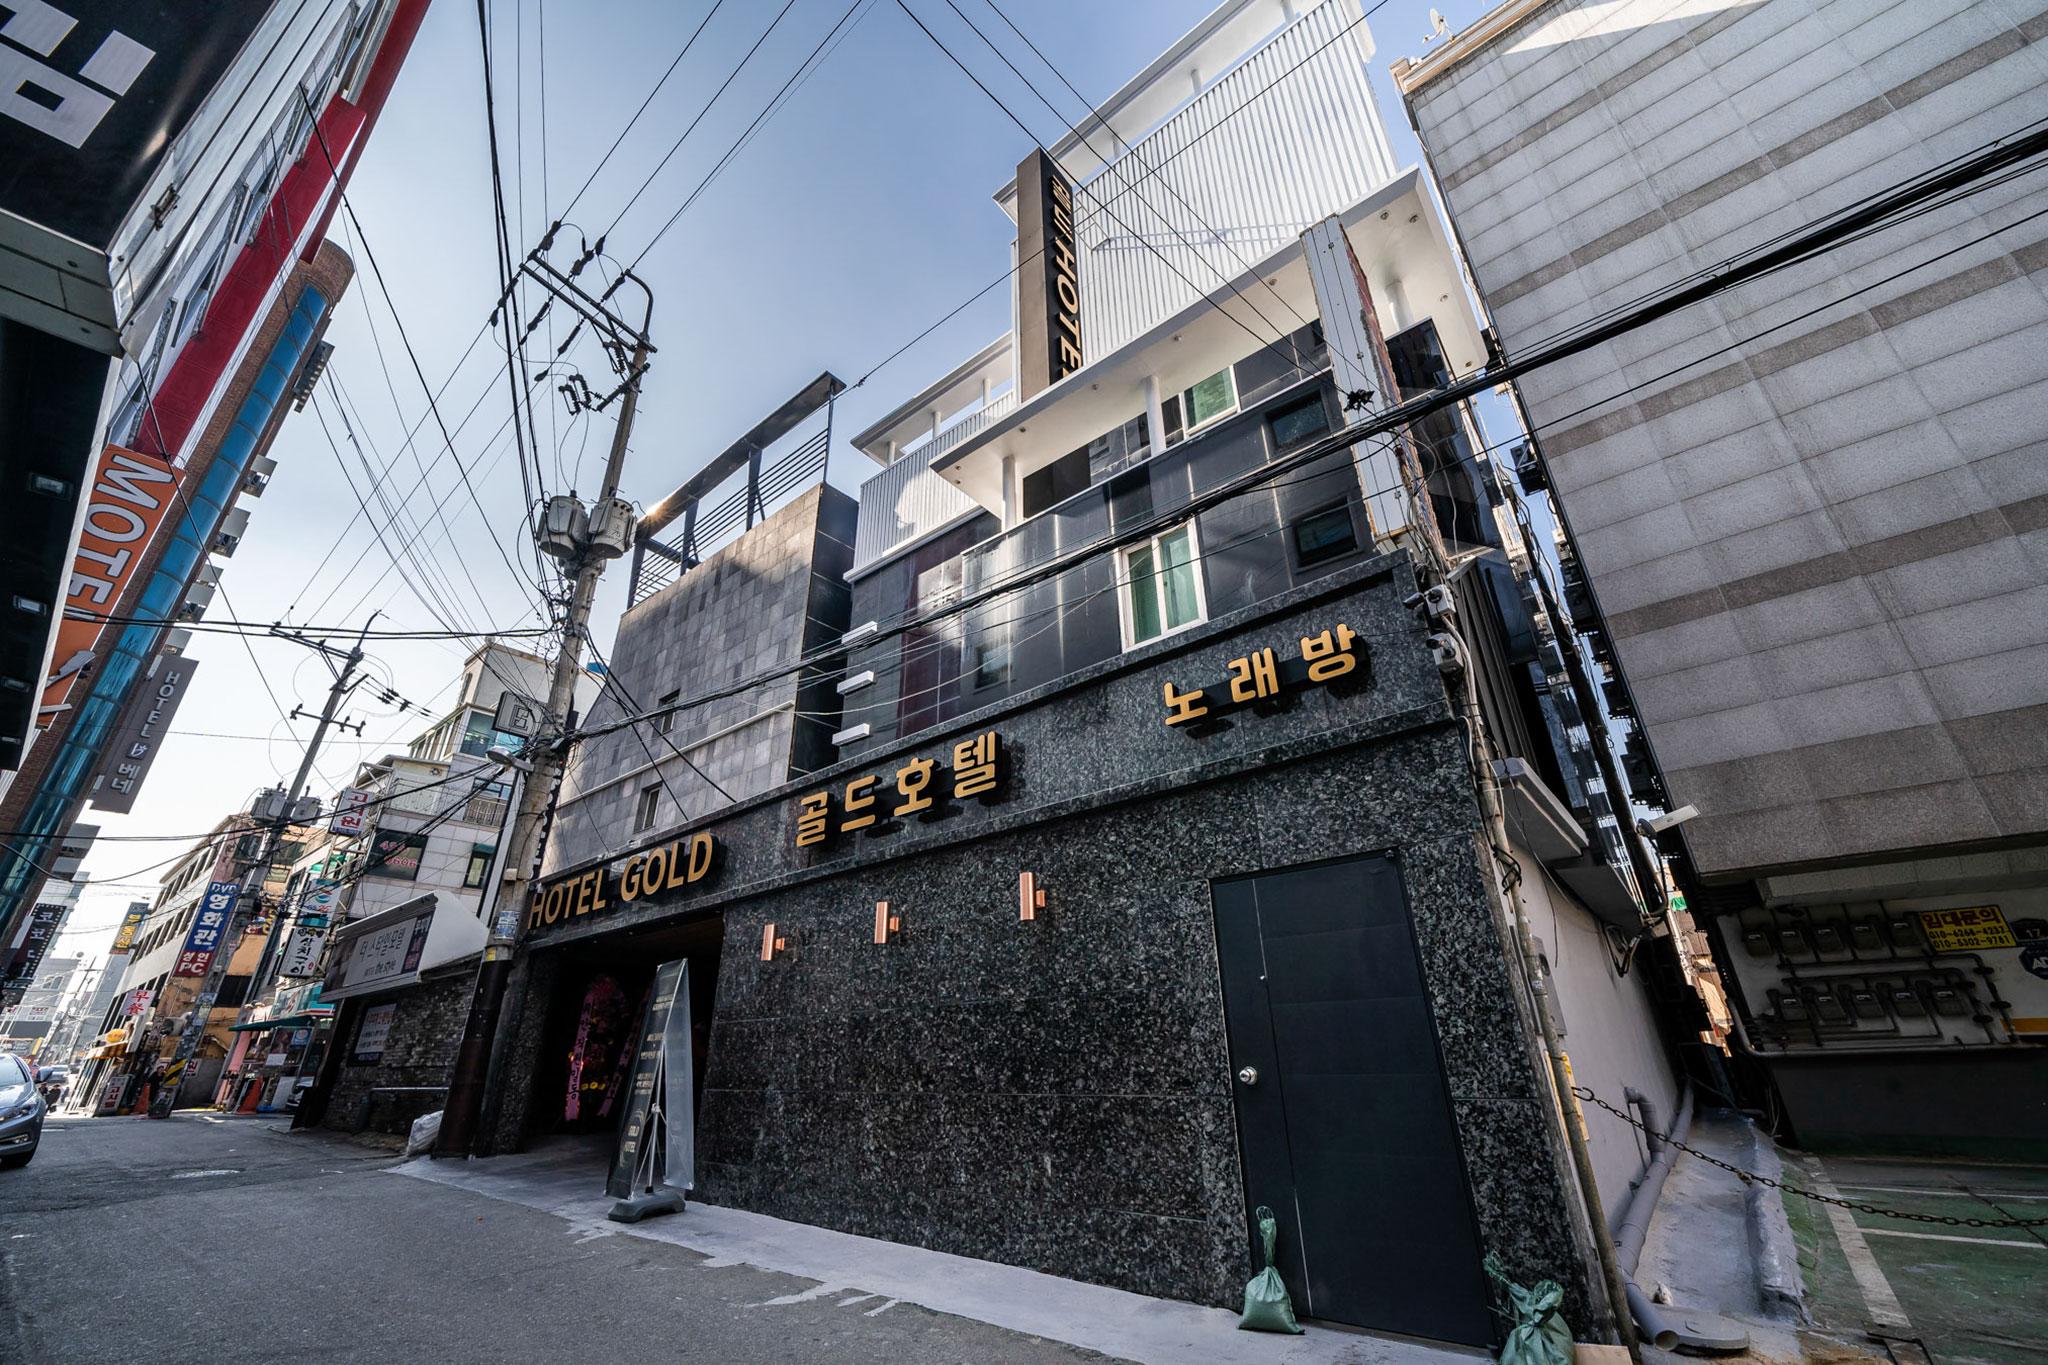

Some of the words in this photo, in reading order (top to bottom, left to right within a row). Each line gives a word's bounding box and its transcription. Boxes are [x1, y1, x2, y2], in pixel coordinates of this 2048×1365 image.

[1055, 236, 1083, 378] HOTE
[140, 671, 181, 738] HOTEL
[1163, 623, 1358, 727] 노래방
[796, 731, 997, 848] 골드호텔
[194, 894, 231, 946] 영화관
[527, 868, 607, 930] HOTEL
[620, 831, 714, 902] GOLD
[178, 962, 205, 974] PC
